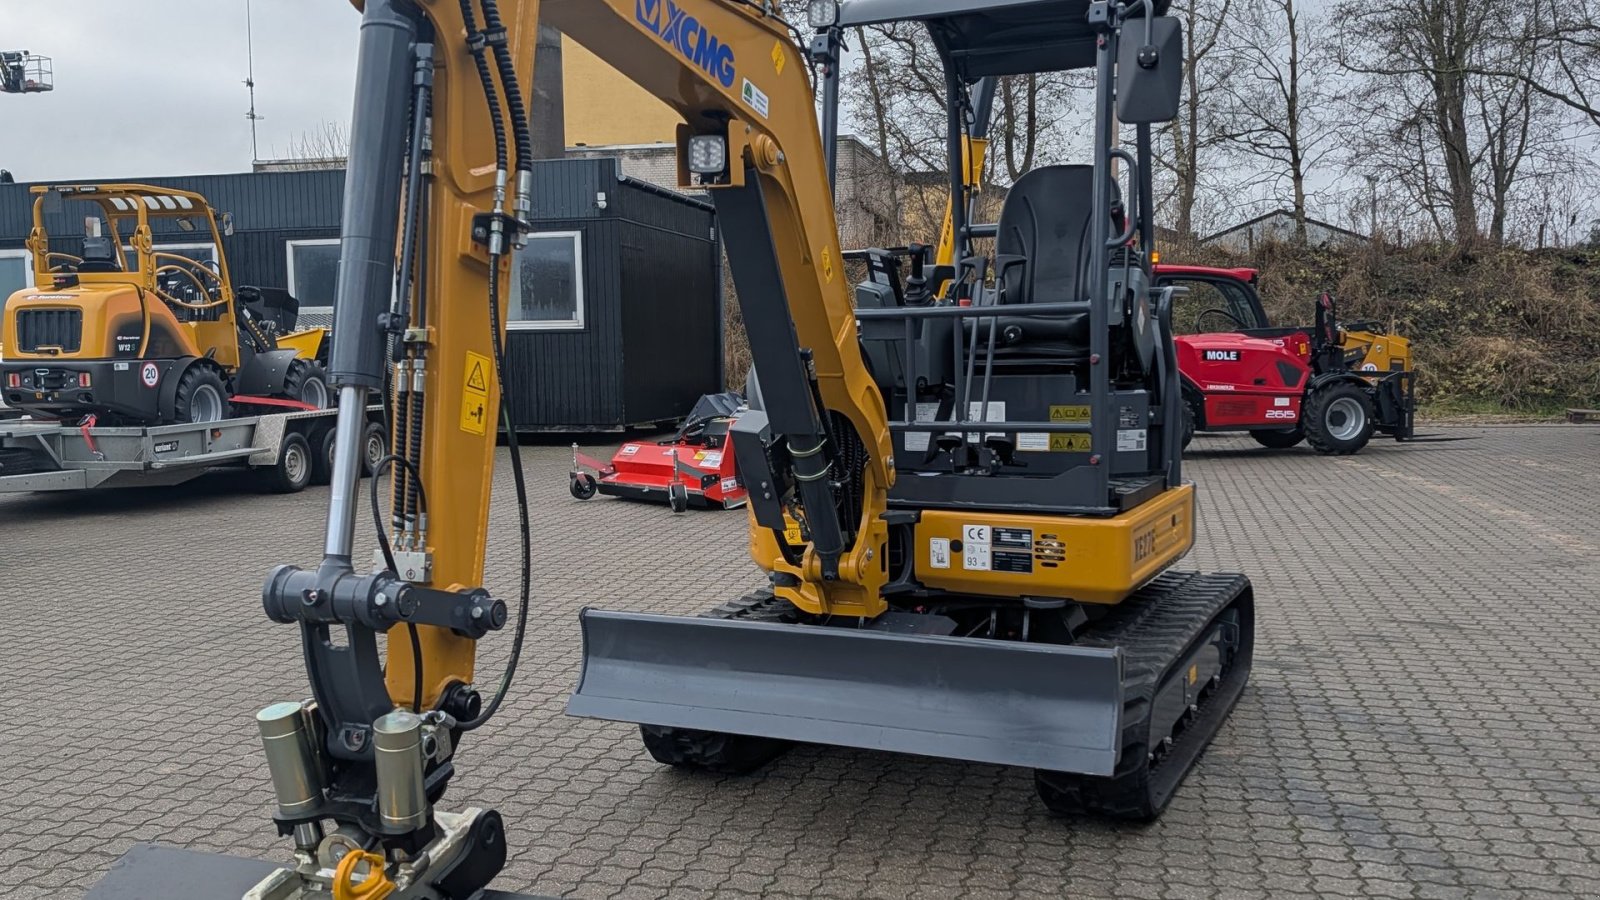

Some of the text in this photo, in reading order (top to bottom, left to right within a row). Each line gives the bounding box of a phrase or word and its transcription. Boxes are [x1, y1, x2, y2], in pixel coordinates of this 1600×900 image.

[660, 0, 735, 88] XCMG
[118, 343, 131, 351] W12
[1206, 351, 1237, 360] MOLE
[145, 368, 156, 379] 20
[1265, 409, 1296, 418] 2615
[968, 528, 984, 540] CE
[967, 557, 977, 566] 93
